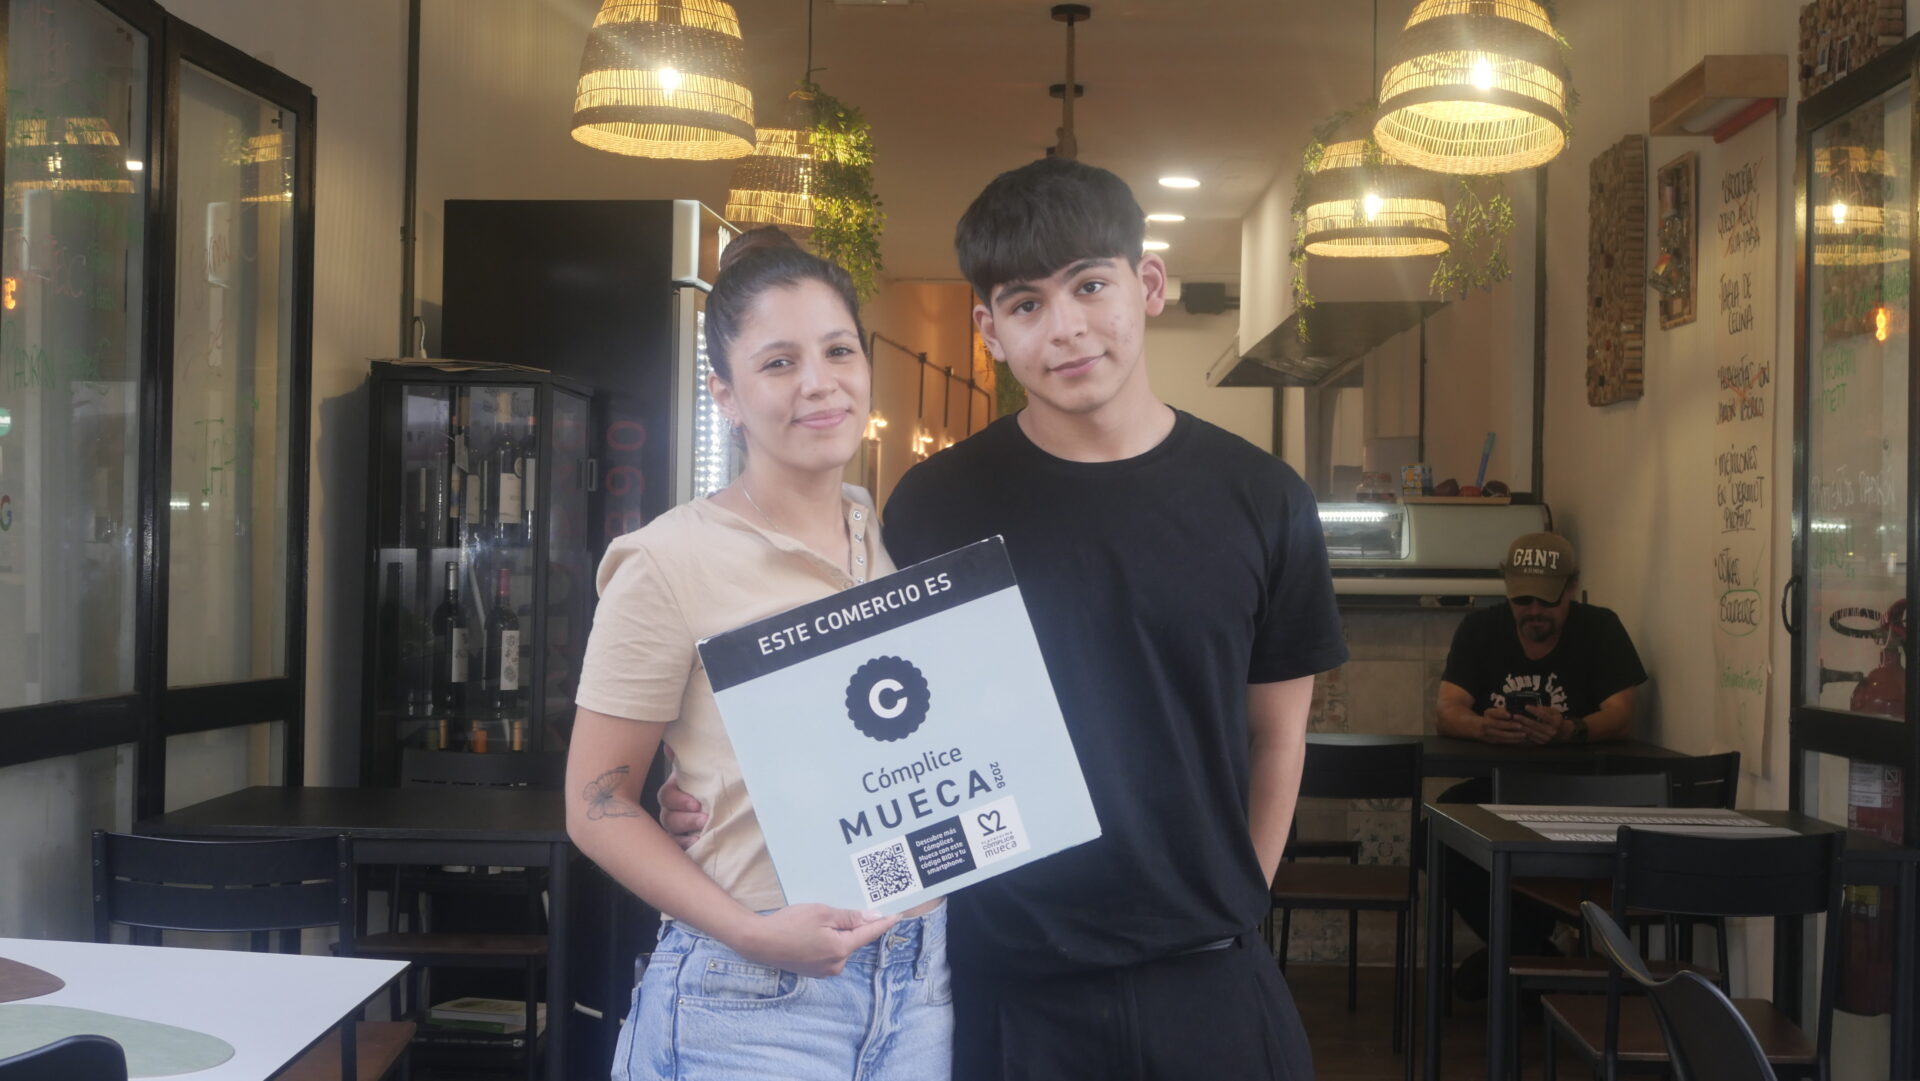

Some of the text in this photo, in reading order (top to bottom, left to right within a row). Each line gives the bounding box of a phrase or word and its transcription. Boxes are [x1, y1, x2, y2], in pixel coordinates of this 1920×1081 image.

[1743, 272, 1752, 299] DE
[1513, 549, 1560, 569] GANT
[758, 572, 951, 655] ESTE COMERCIO ES
[862, 747, 963, 793] Cómplice
[839, 762, 1006, 845] MUECA 2026
[915, 827, 957, 847] Descubre más
[923, 837, 954, 852] Cómplices
[918, 841, 963, 862] Mueca con este
[984, 840, 1017, 858] mueca
[920, 858, 941, 870] código
[941, 853, 954, 862] BIDI
